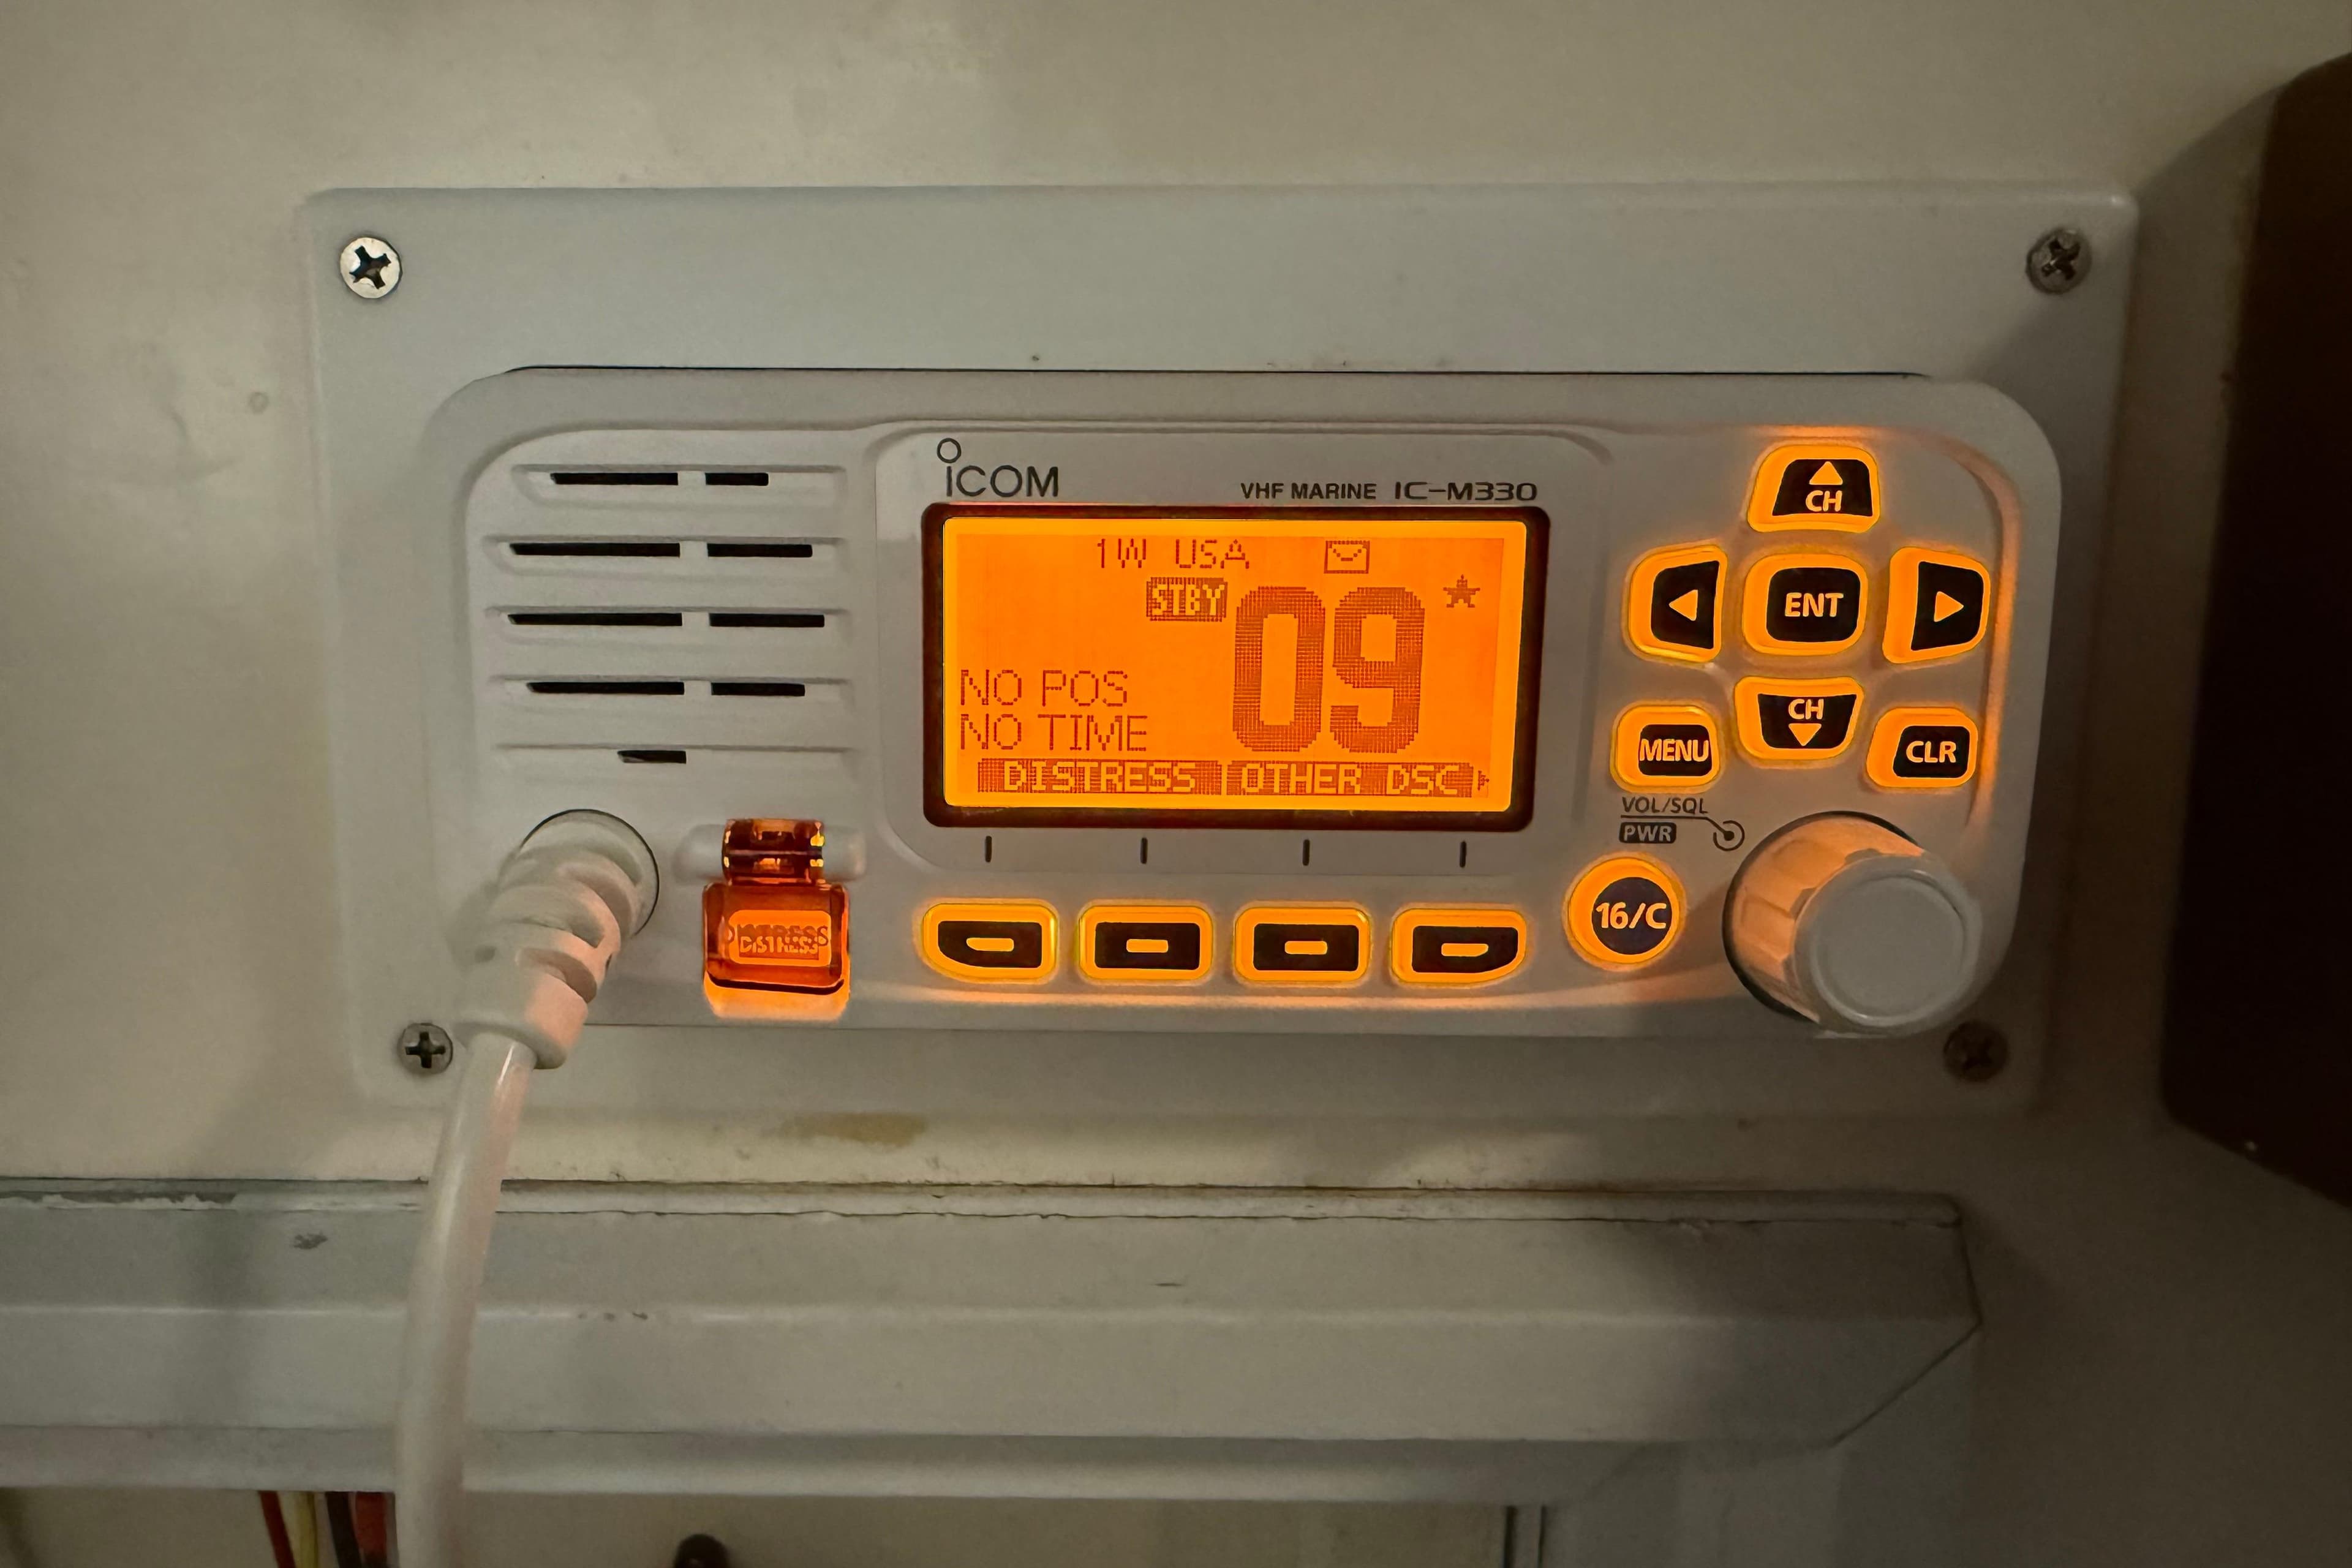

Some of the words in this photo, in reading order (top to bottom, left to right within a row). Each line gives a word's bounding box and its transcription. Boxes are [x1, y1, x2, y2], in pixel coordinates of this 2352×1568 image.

[1240, 482, 1284, 500] VHF
[1291, 483, 1378, 500] MARINE
[1394, 481, 1538, 502] IC-M330
[1804, 489, 1843, 513] CH
[1175, 538, 1250, 570] USA
[1151, 582, 1226, 617] STBY
[1784, 592, 1844, 617] ENT
[1232, 586, 1425, 753] 09
[960, 669, 1022, 706] NO
[1042, 670, 1128, 707] POS
[1787, 698, 1825, 721] CH
[960, 713, 1022, 750] NO
[1037, 714, 1148, 752] TIME
[1638, 737, 1710, 763] MENU
[1905, 740, 1957, 764] CLR
[1003, 760, 1196, 793] DISTRESS
[1240, 763, 1362, 795] OTHER
[1385, 764, 1460, 796] DSC
[1621, 797, 1709, 816] VOL/SQL
[1623, 825, 1673, 843] PWR
[1596, 901, 1668, 930] 16/C
